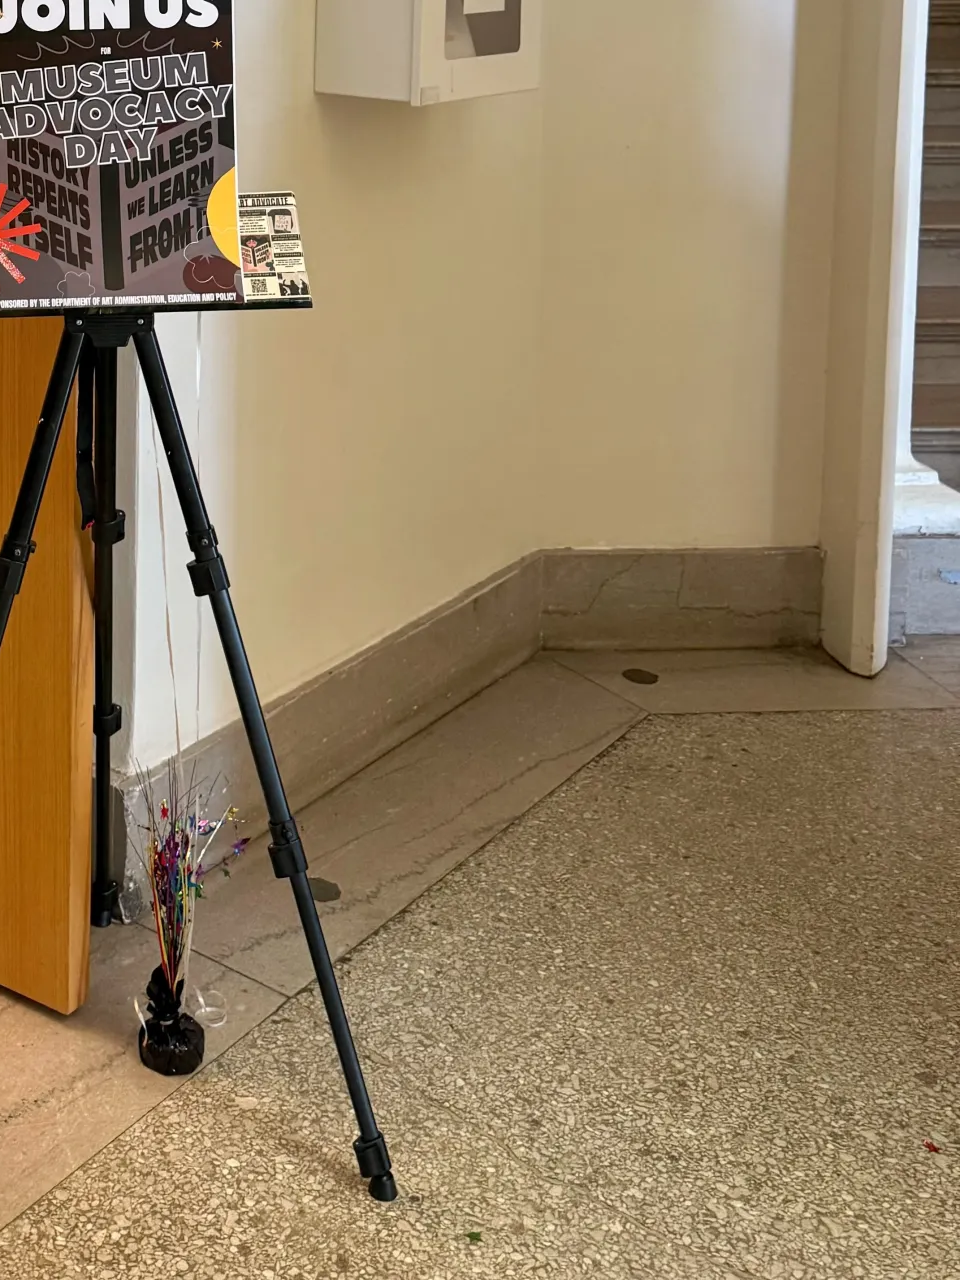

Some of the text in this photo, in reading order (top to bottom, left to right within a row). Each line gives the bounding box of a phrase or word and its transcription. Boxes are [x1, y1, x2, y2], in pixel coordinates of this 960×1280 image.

[100, 46, 111, 55] FOR
[63, 126, 158, 169] DAY
[125, 120, 214, 189] UNLESS
[7, 163, 91, 231] REPEATS
[127, 156, 215, 220] WE LEARN
[251, 197, 289, 206] ADVOCATE
[128, 207, 193, 273] FROM
[29, 299, 38, 308] BY
[39, 298, 51, 307] THE
[52, 297, 91, 307] DEPARTMENT
[93, 297, 101, 305] OF
[101, 296, 113, 305] ART
[114, 294, 167, 305] ADMINISTRATION,
[167, 293, 201, 303] EDUCATION
[201, 293, 215, 302] AND
[215, 292, 237, 301] POLICY
